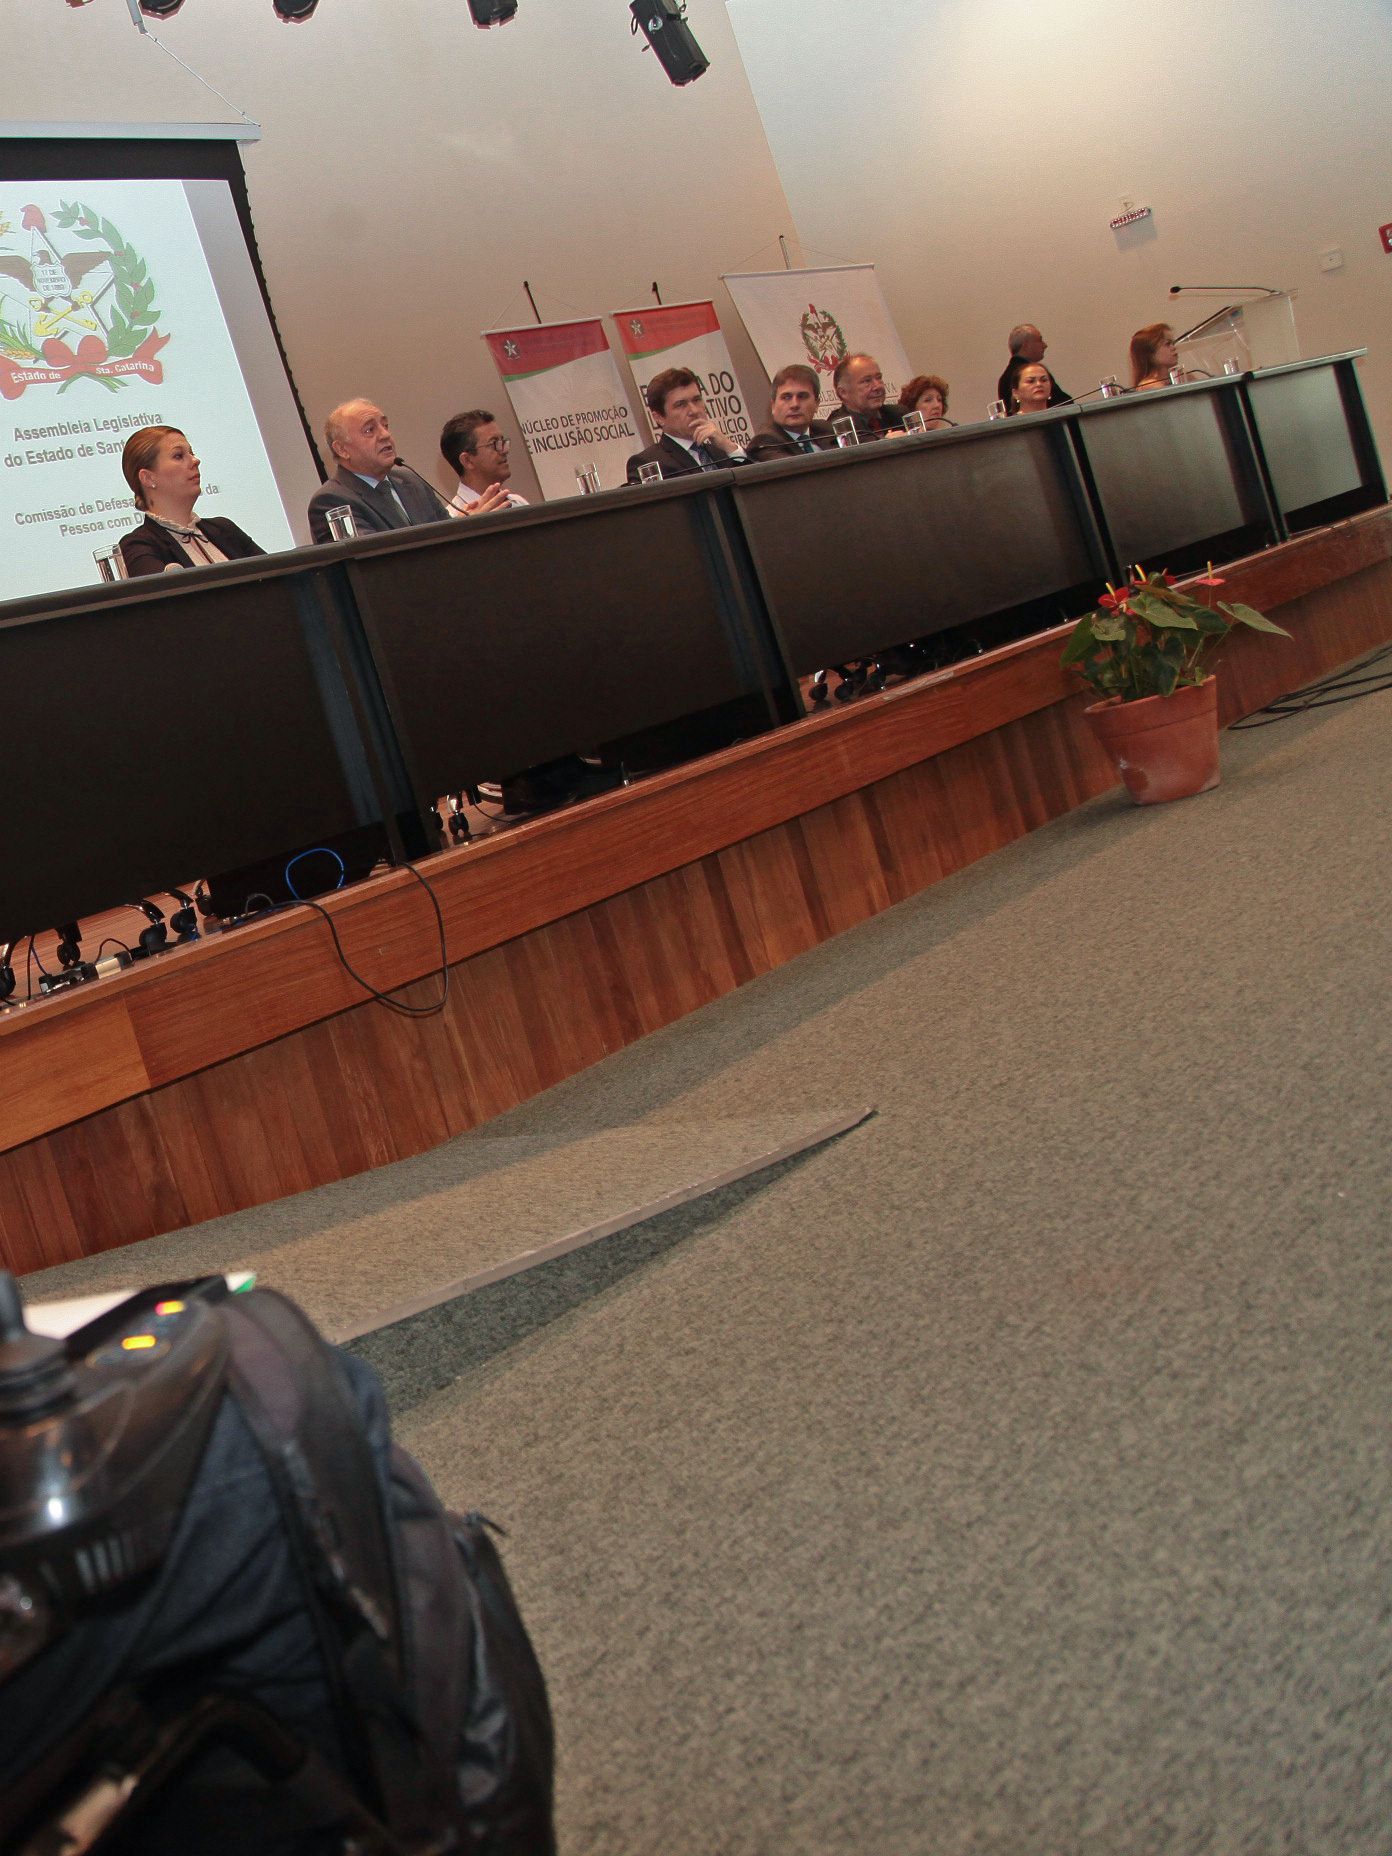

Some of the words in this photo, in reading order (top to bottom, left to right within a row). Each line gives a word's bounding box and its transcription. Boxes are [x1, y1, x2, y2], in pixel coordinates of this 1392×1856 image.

[10, 371, 47, 384] Estado
[48, 371, 61, 380] de
[95, 366, 113, 375] Sta.
[114, 360, 155, 373] Catarina
[708, 370, 735, 395] DO
[13, 420, 92, 442] Assembleia
[92, 412, 163, 433] Legislativa
[520, 417, 559, 436] NÚCLEO
[560, 414, 576, 428] DE
[575, 405, 628, 425] PROMOÇÃO
[532, 426, 594, 454] INCLUSÃO
[593, 422, 636, 442] SOCIAL
[3, 454, 23, 468] do
[25, 447, 74, 466] Estado
[77, 444, 95, 458] de
[95, 439, 125, 456] Sant
[14, 504, 76, 526] Comissão
[78, 502, 94, 516] de
[205, 483, 219, 495] da
[59, 521, 103, 537] Pessoa
[106, 516, 132, 530] com
